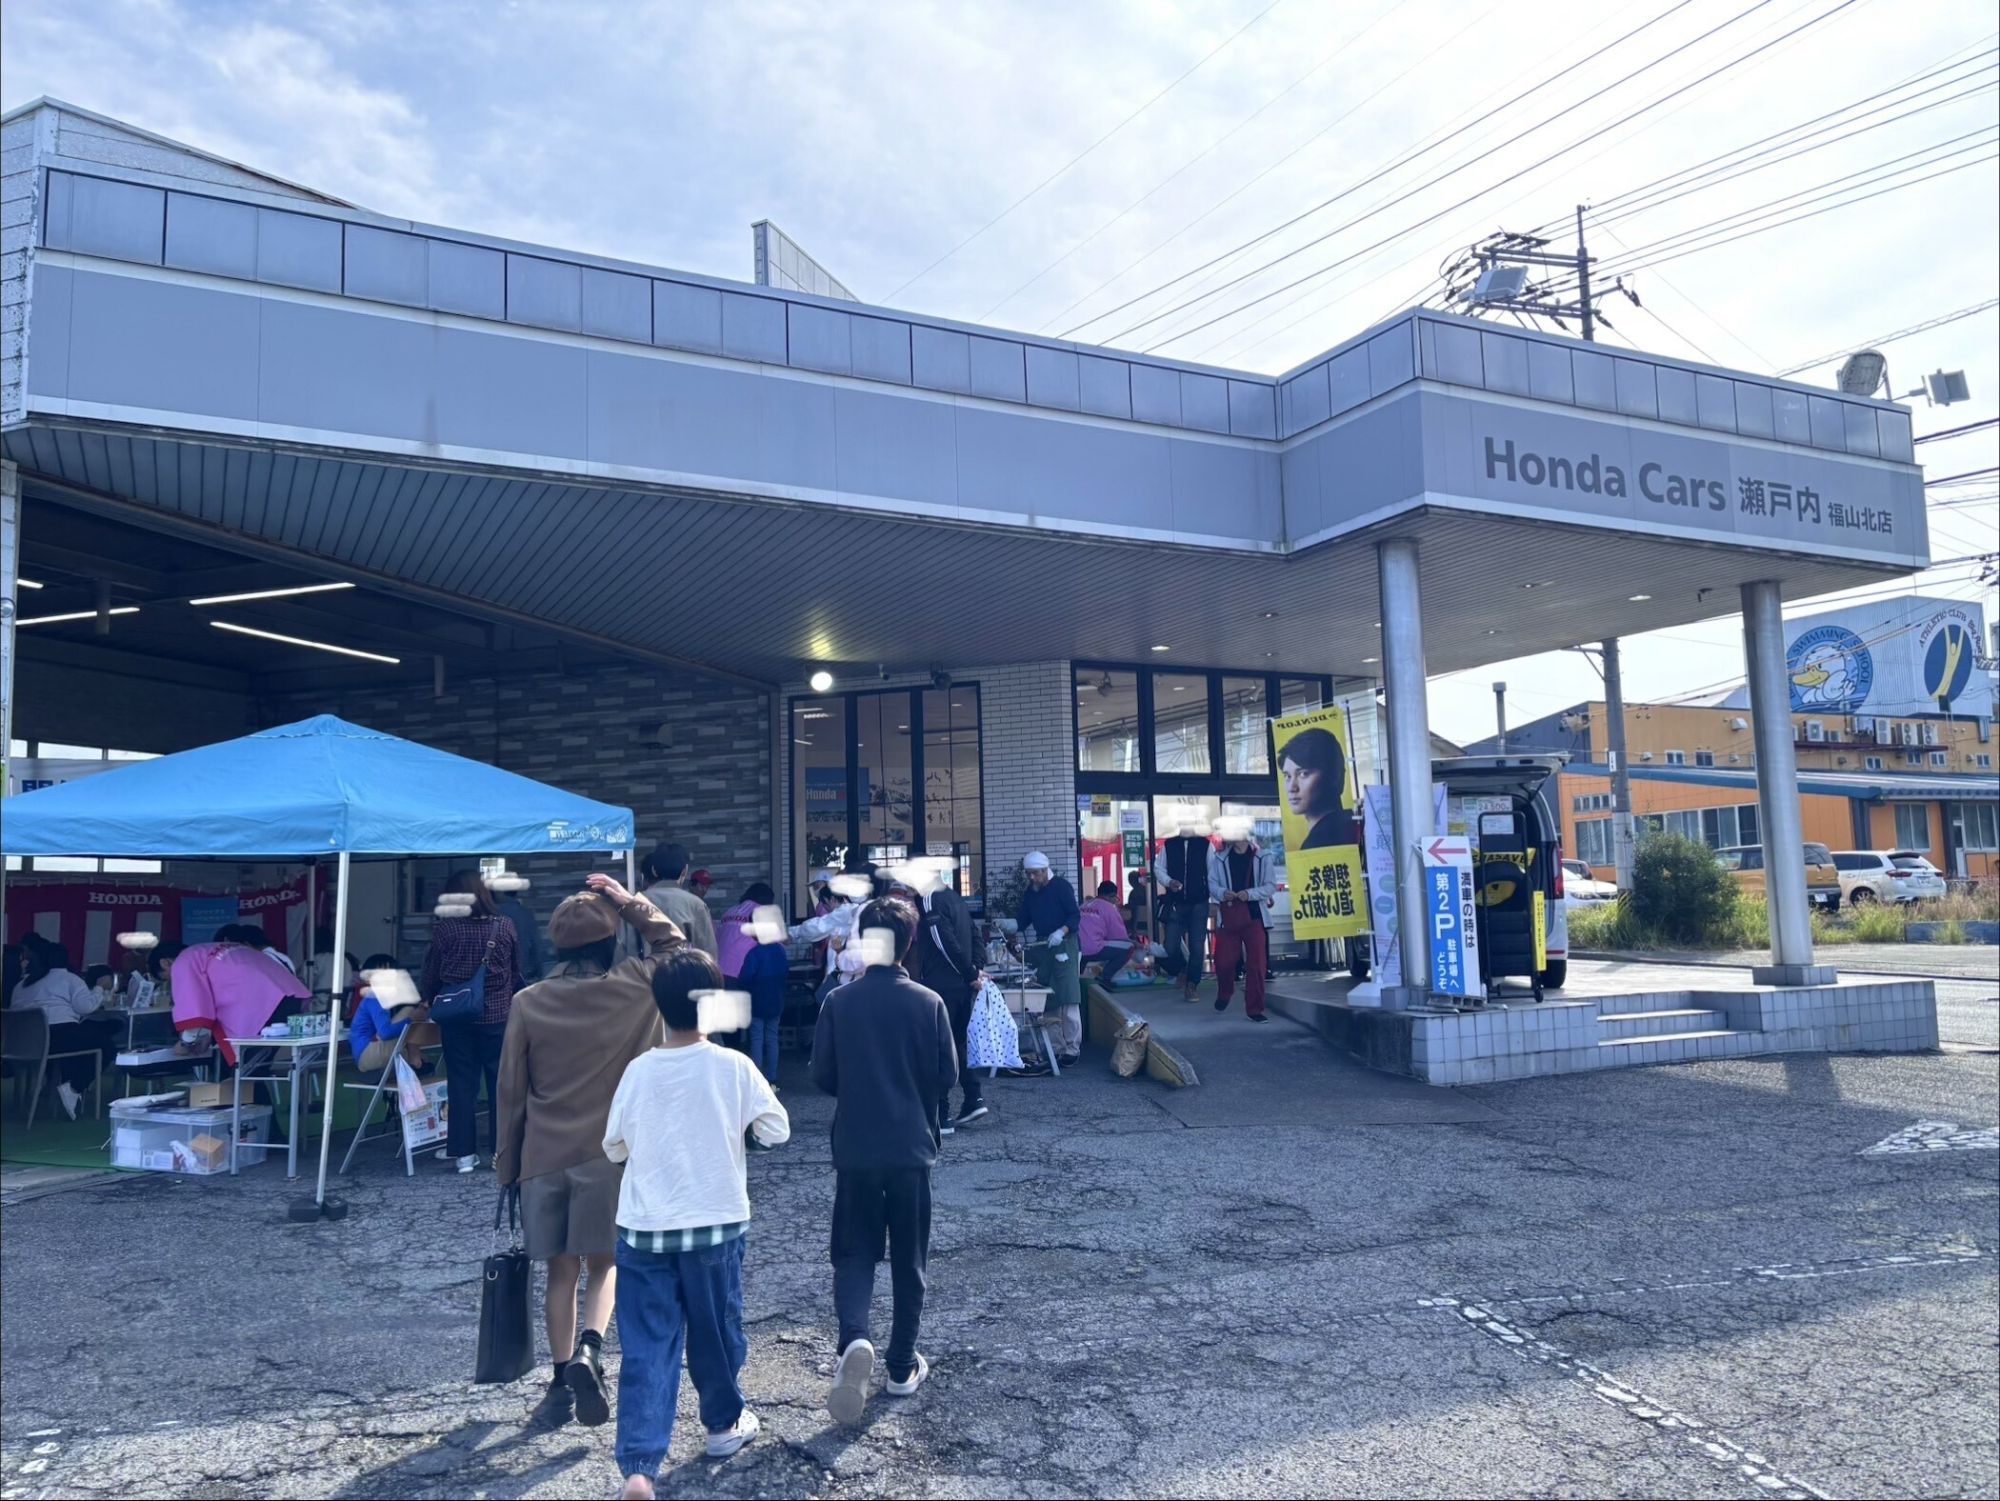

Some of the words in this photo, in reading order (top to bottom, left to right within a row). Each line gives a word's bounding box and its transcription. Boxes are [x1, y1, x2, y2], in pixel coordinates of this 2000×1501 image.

[1483, 436, 1627, 499] Honda
[1638, 462, 1727, 512] Cars
[1737, 476, 1821, 525] 瀬戸内
[1827, 501, 1893, 535] 福山北店
[1794, 628, 1850, 655] SWIMMING
[806, 788, 837, 800] Honda
[88, 892, 163, 905] HONDA
[1461, 872, 1475, 948] 満車の時は
[1437, 951, 1448, 990] どうぞ
